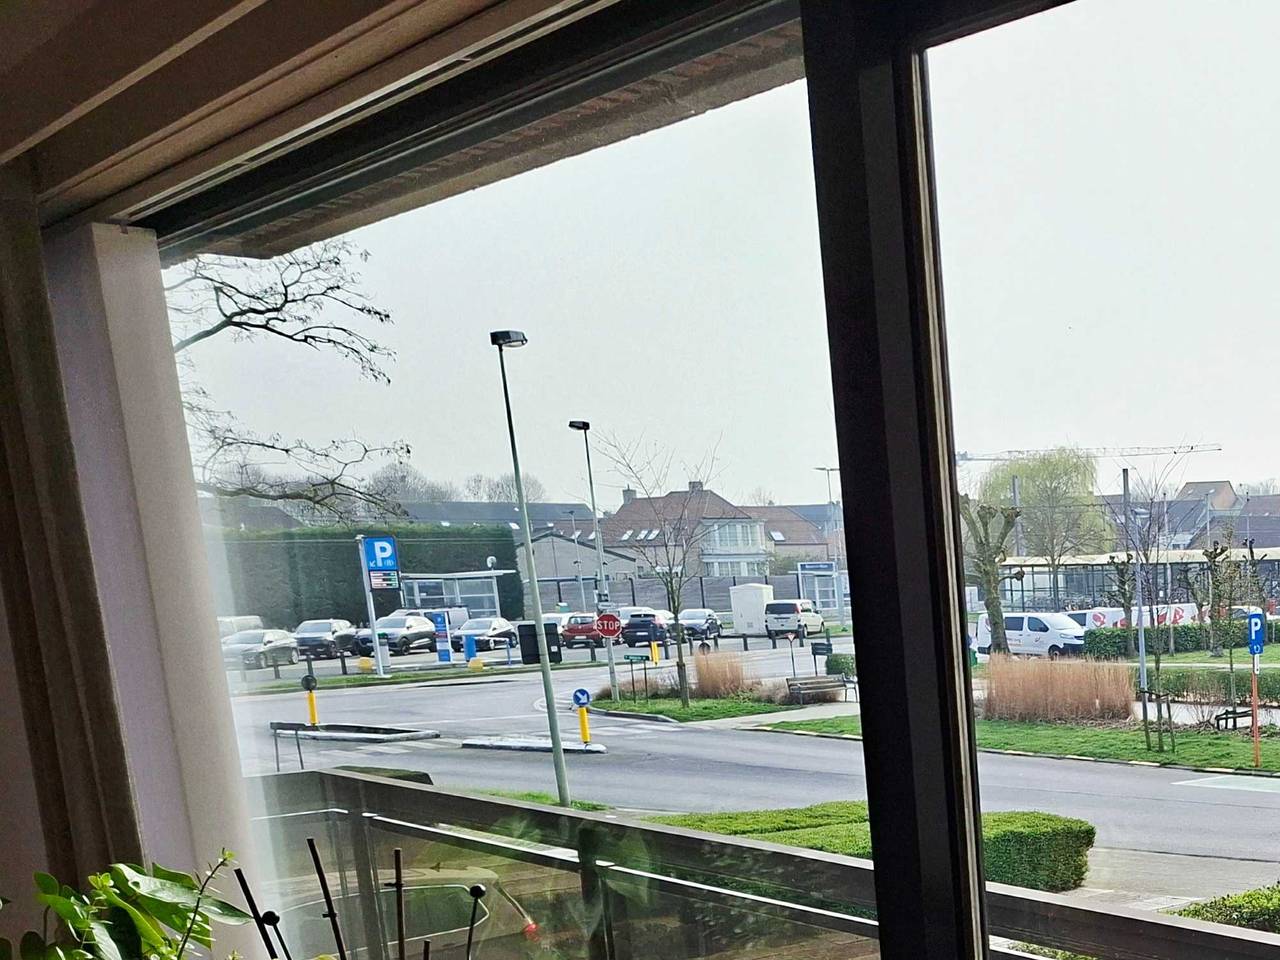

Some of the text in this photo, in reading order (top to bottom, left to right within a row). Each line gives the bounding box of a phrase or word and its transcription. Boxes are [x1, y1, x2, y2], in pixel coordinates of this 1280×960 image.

[374, 541, 393, 568] P
[597, 620, 620, 630] STOP
[1251, 618, 1261, 640] P
